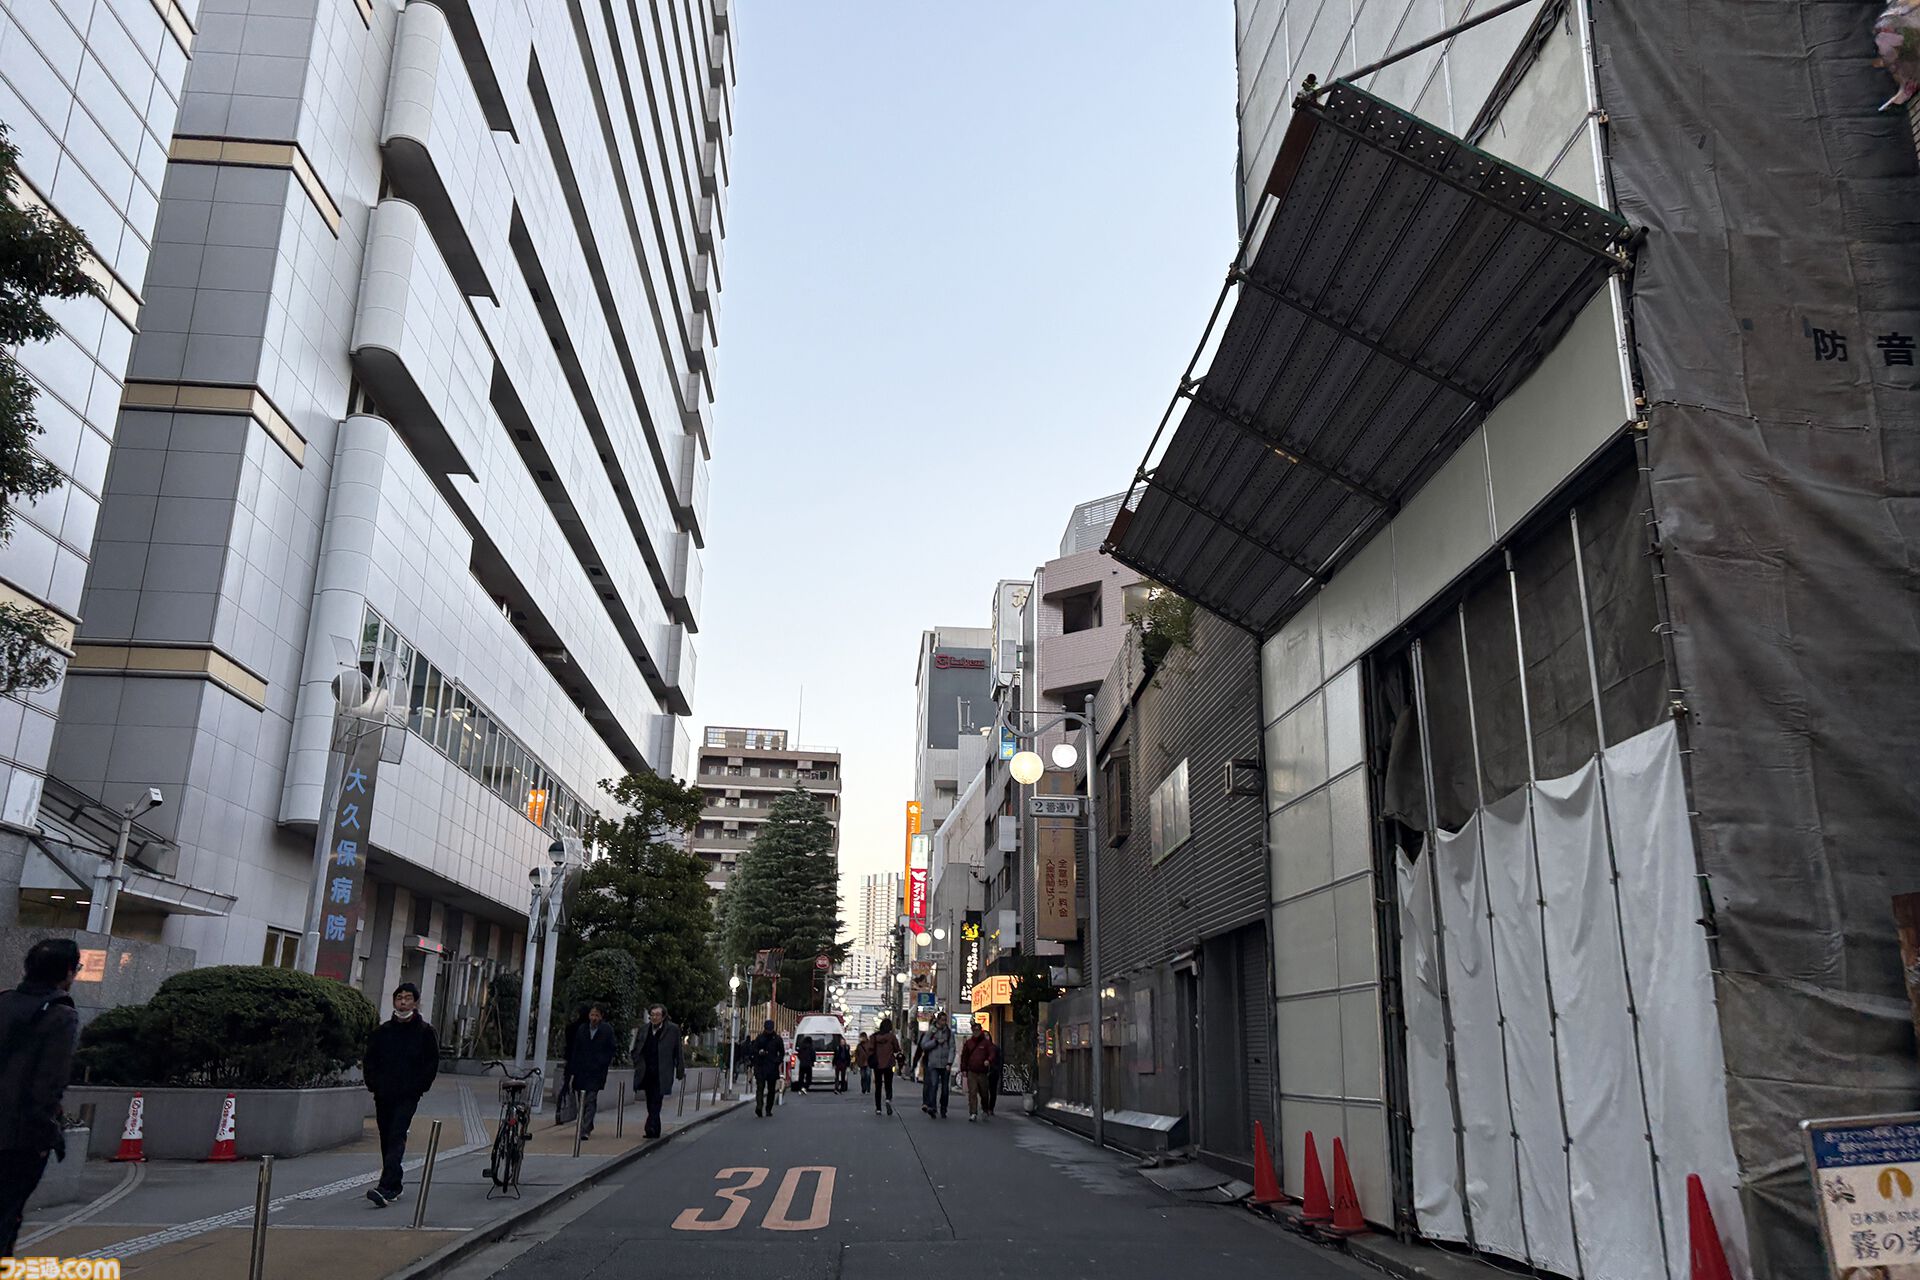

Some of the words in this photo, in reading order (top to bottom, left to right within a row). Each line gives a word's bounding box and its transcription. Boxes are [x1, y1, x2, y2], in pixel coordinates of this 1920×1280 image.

[1812, 327, 1917, 367] 防音
[1034, 801, 1075, 814] 2番通り
[324, 767, 369, 942] 大久保病院
[671, 1165, 838, 1232] 30
